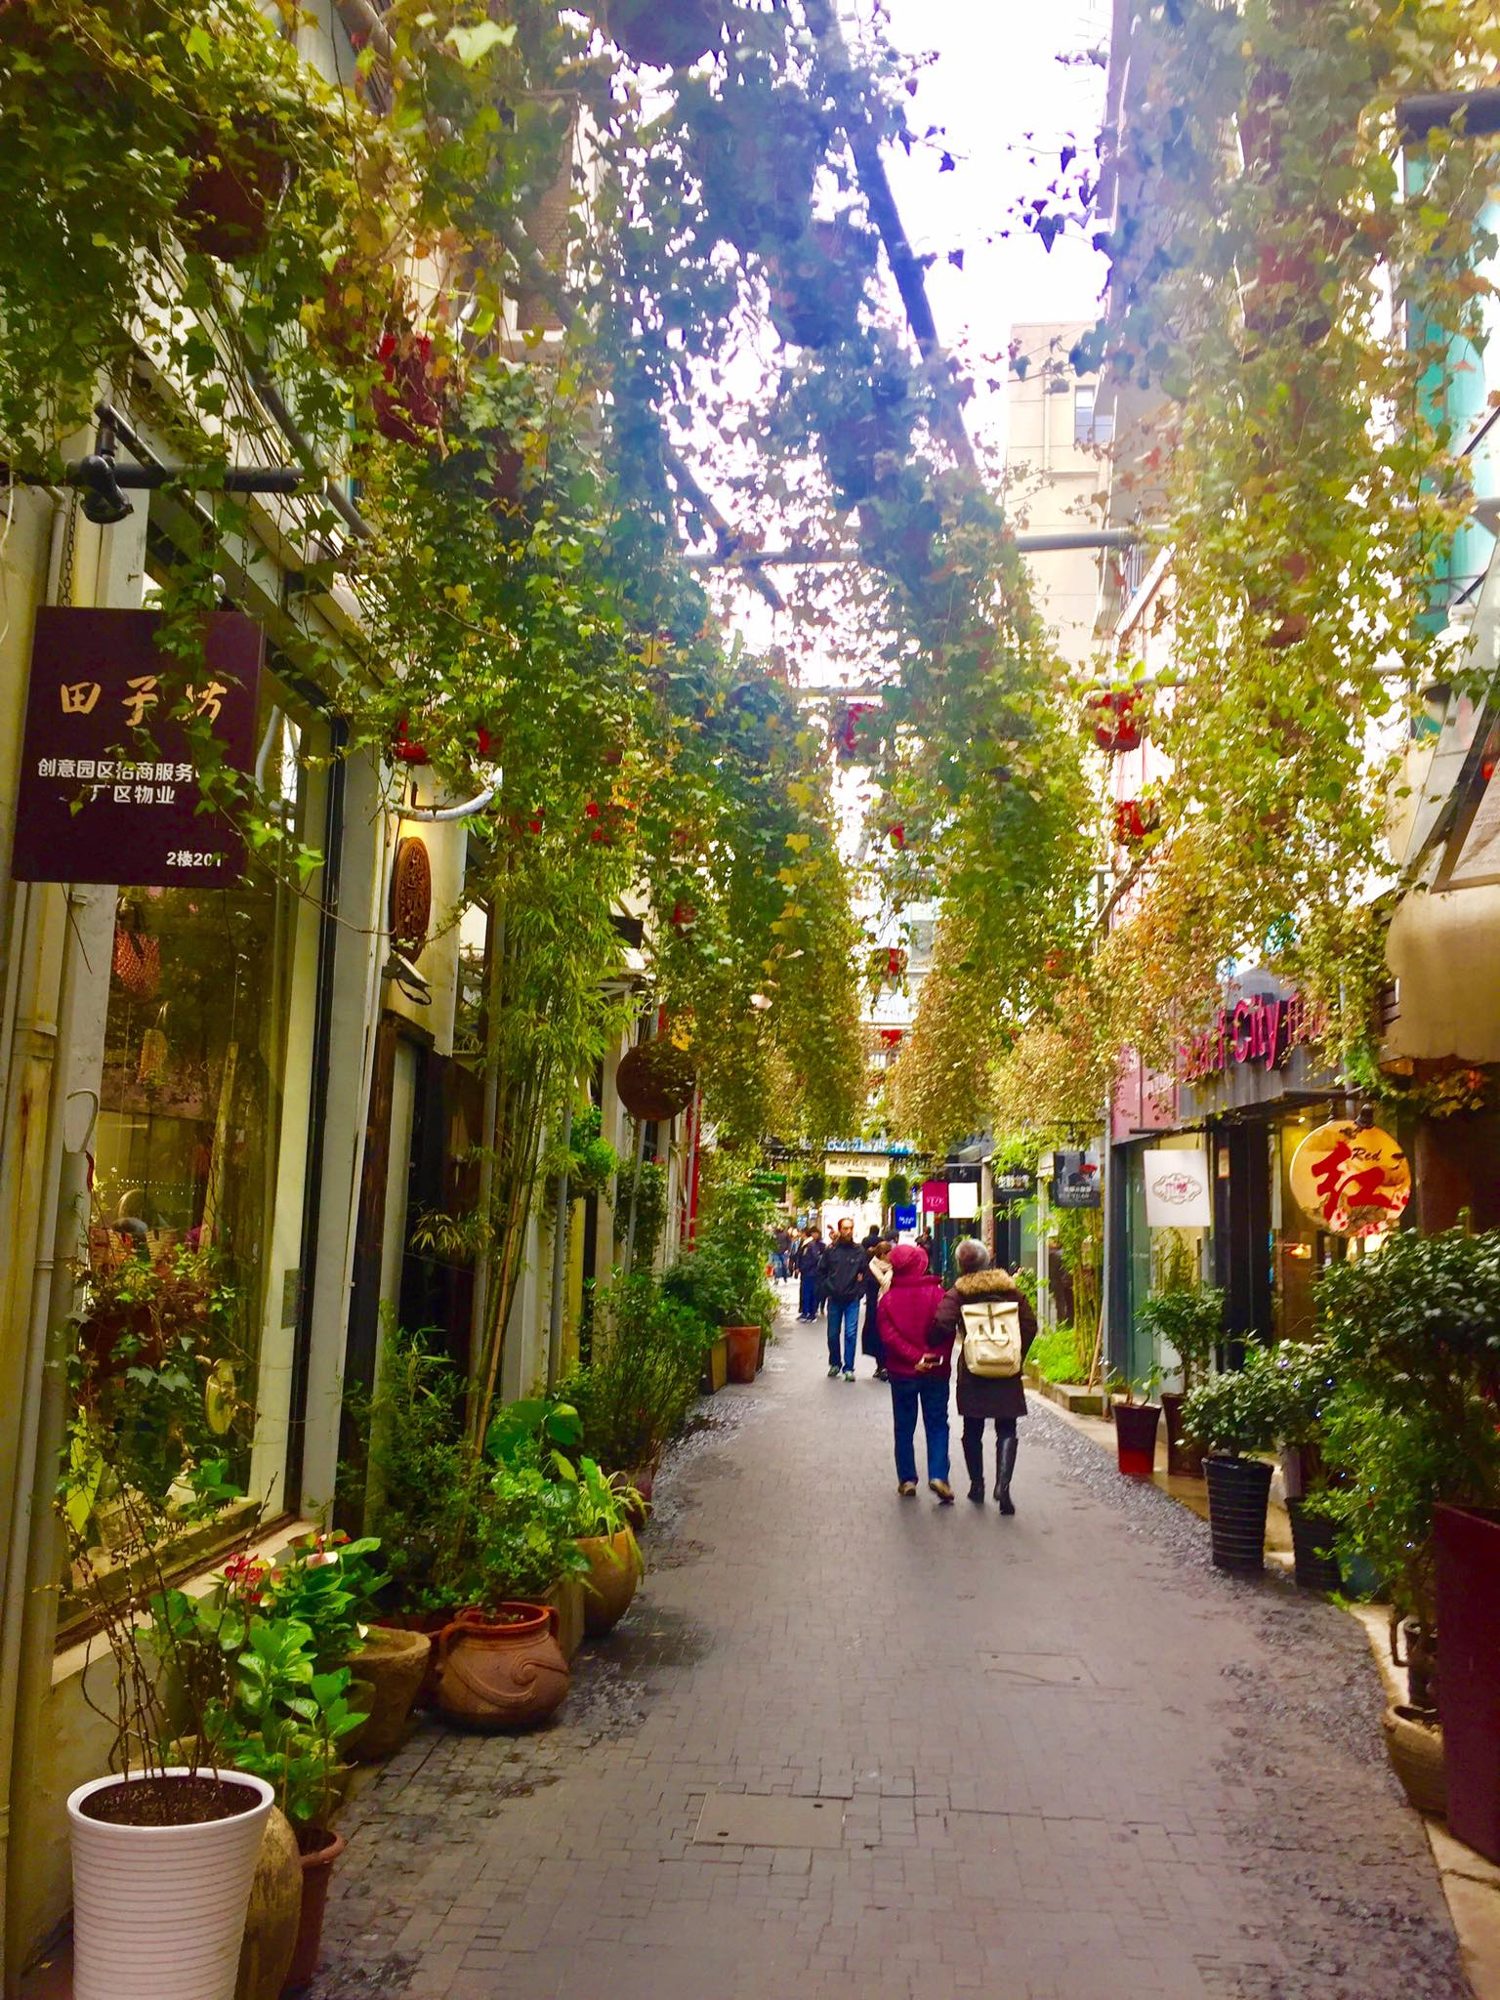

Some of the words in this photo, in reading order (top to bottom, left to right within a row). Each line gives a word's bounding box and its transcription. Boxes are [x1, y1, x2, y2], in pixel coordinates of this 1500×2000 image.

[61, 674, 228, 726] 田子坊
[38, 757, 227, 783] 创意园区招商服务
[89, 784, 175, 805] 厂区物业
[1351, 1147, 1382, 1161] Red
[1311, 1141, 1400, 1223] 红
